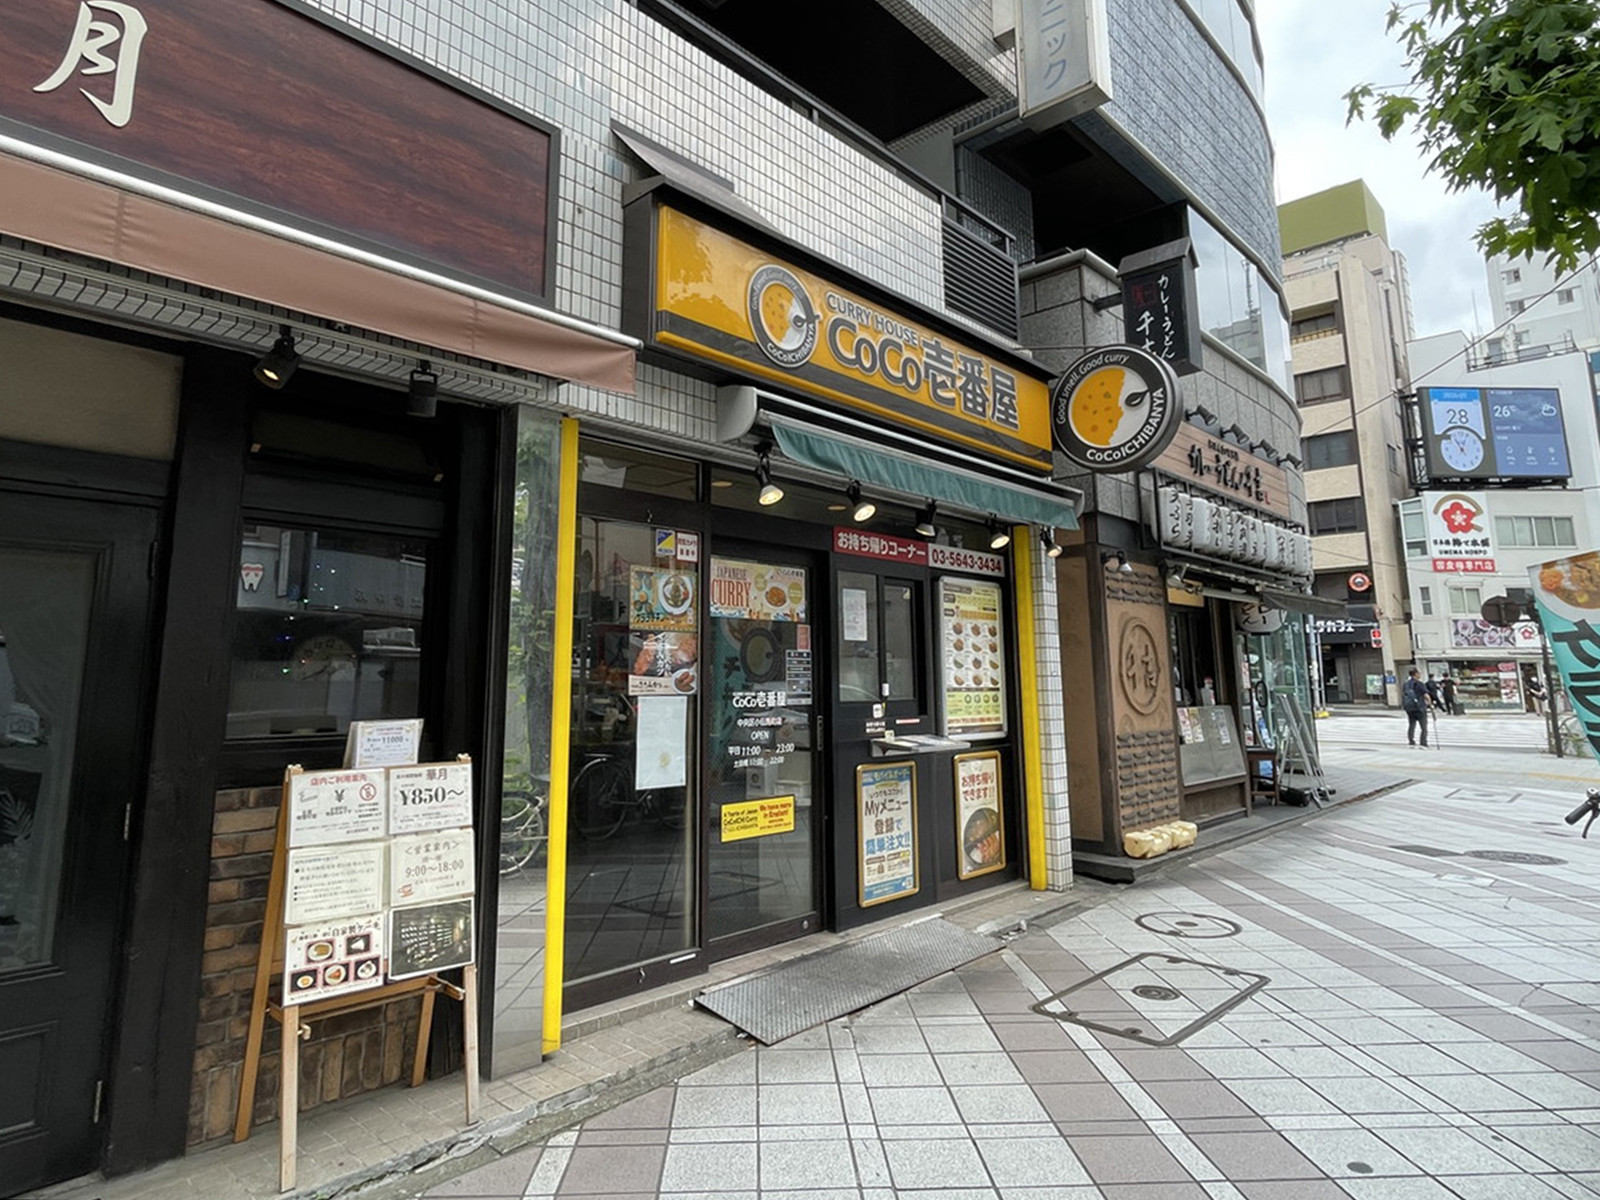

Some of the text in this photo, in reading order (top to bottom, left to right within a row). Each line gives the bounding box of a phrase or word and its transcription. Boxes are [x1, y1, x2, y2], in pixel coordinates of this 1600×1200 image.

[33, 0, 148, 127] 月
[827, 293, 919, 346] CURRY HOUSE
[828, 316, 1019, 430] CoCo壱番屋
[1056, 397, 1066, 425] Good
[1079, 354, 1104, 375] Good
[1104, 353, 1130, 365] curry
[1086, 388, 1164, 461] CoCoICHIBANYA
[1446, 408, 1469, 425] 28
[837, 532, 926, 559] お持ち帰りコーナー
[716, 566, 747, 580] JAPANESE
[932, 548, 1002, 573] 03-5643-3434
[711, 578, 752, 608] CURRY
[750, 730, 769, 741] OPEN
[741, 745, 761, 757] 11:00
[775, 742, 795, 754] 23:00
[961, 772, 994, 787] お持ち帰り
[865, 798, 909, 818] Myメニュー
[874, 817, 903, 836] 登録で
